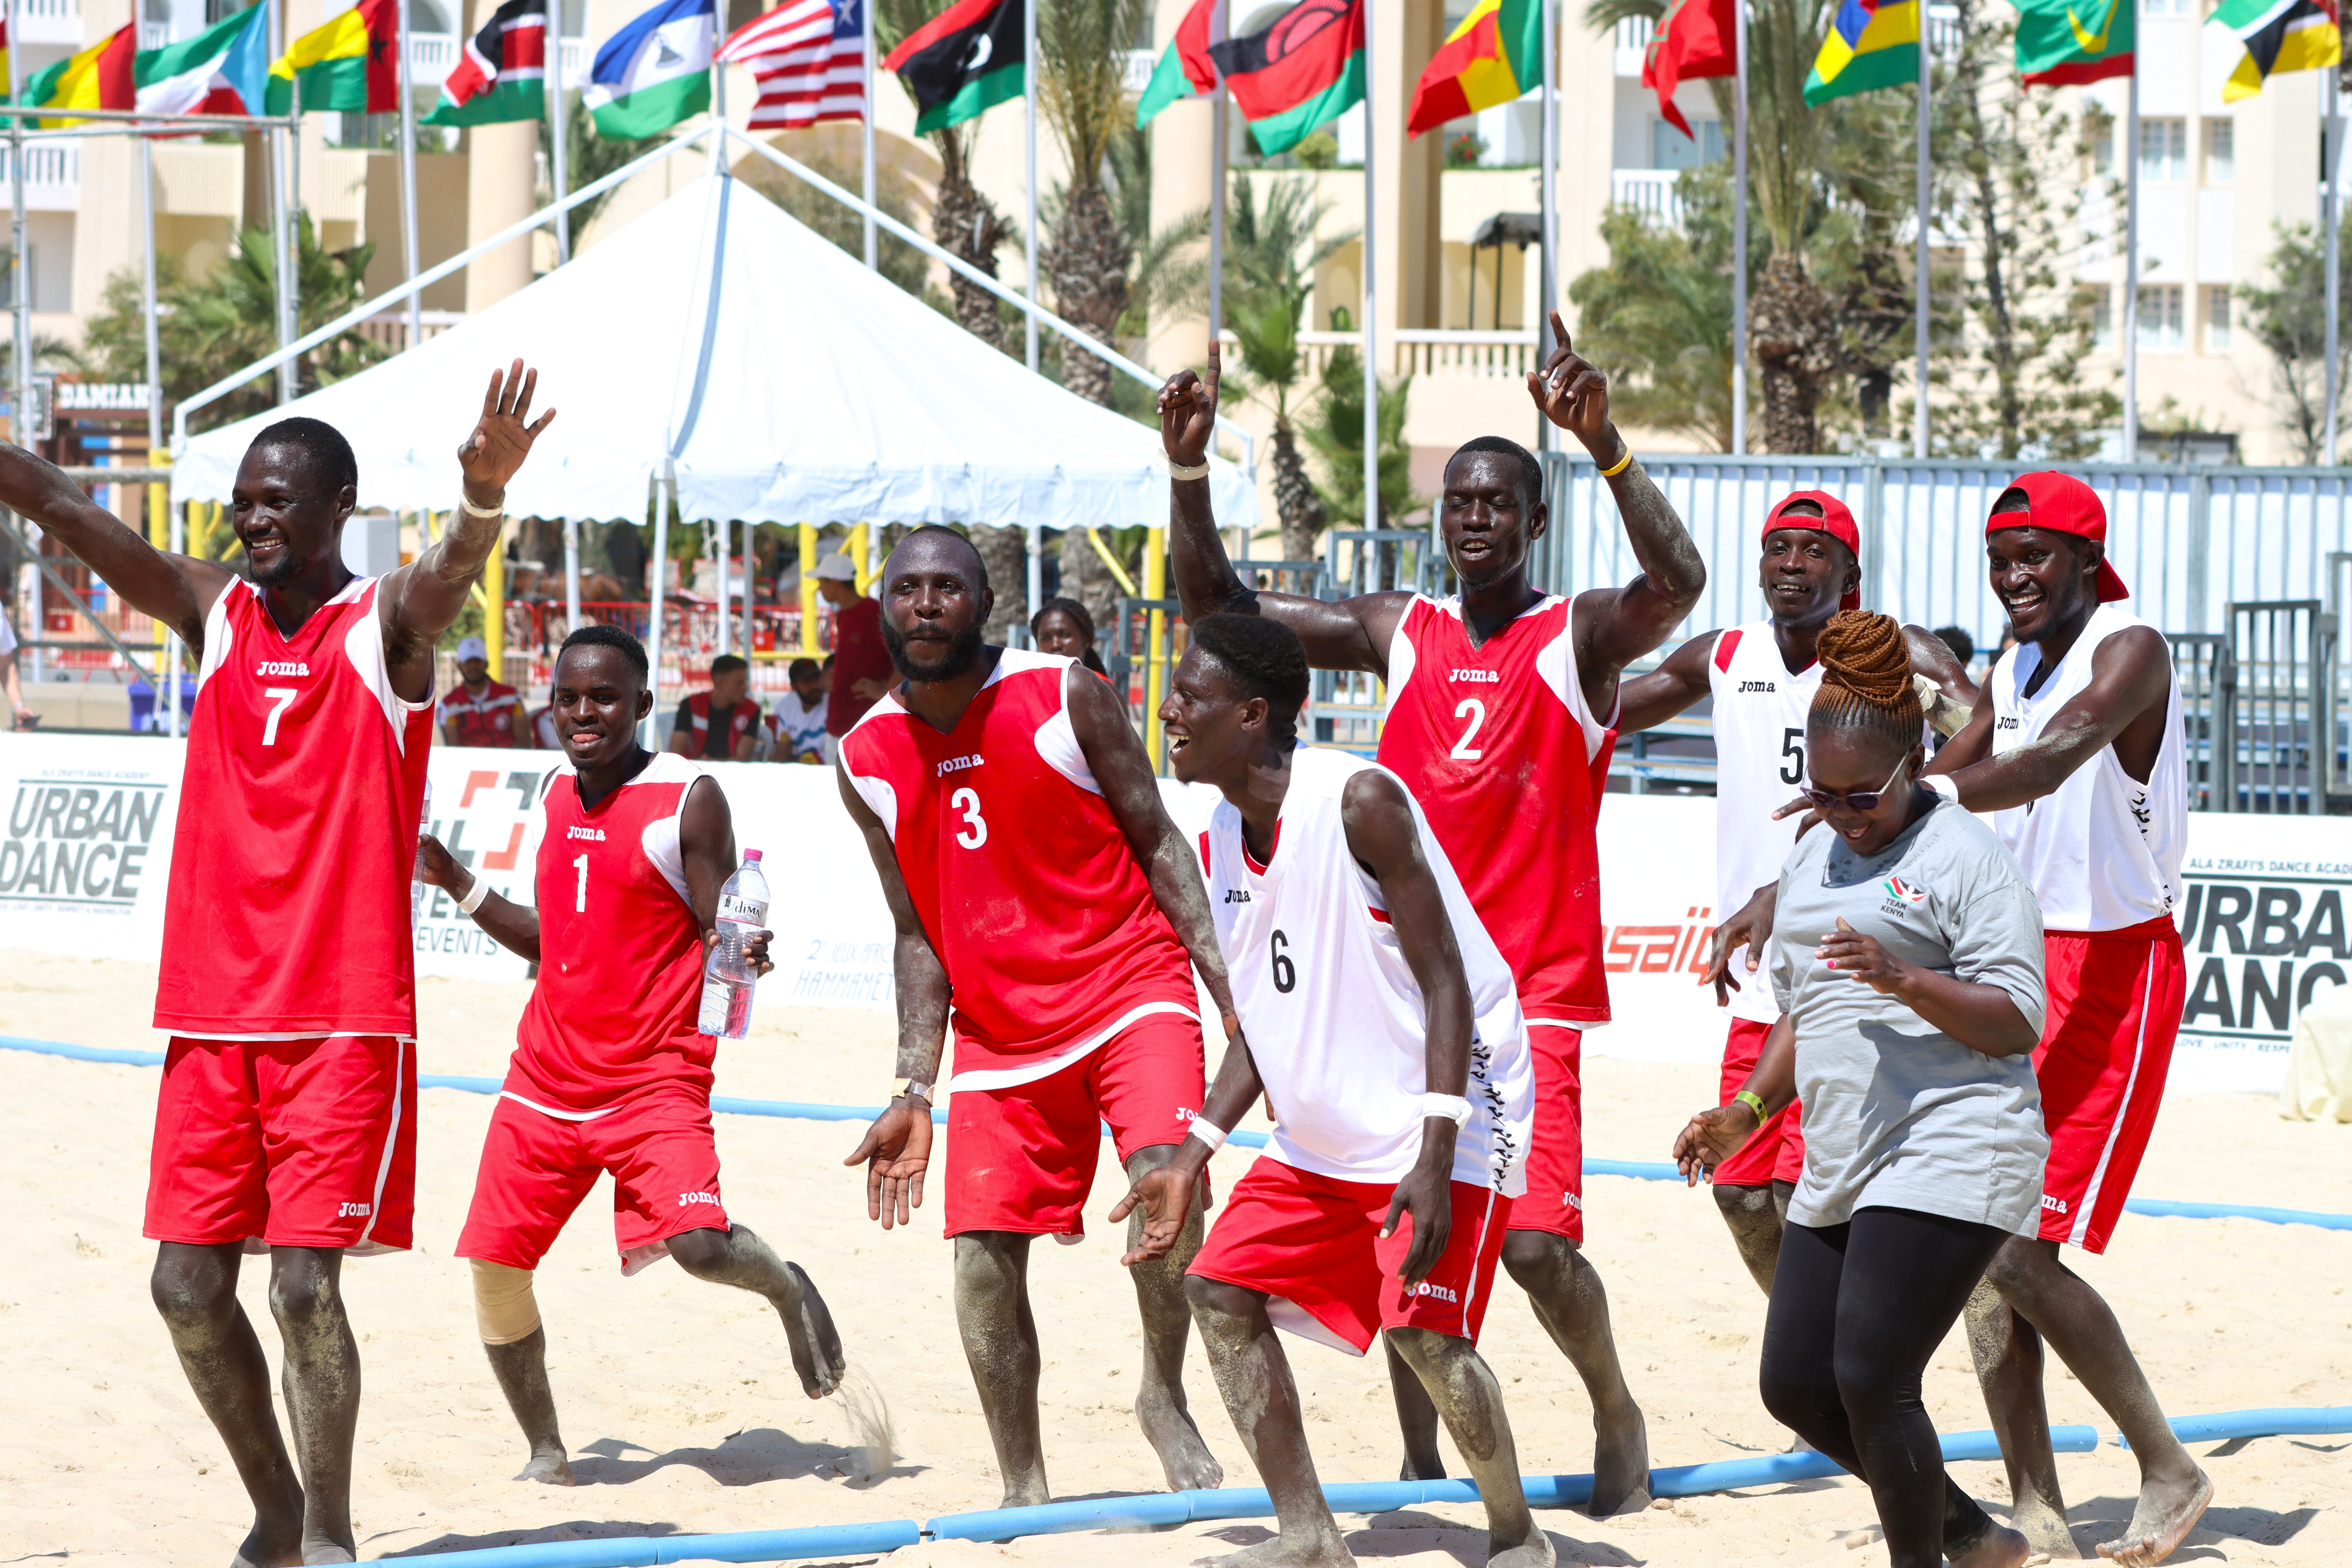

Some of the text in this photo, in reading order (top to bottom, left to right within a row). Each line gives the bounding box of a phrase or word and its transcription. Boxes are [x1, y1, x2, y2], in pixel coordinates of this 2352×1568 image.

[256, 661, 309, 676] Joma
[1449, 669, 1499, 682] Joma
[1738, 681, 1776, 693] Joma
[262, 688, 298, 745] 7
[1450, 699, 1485, 759] 2
[937, 754, 984, 777] Joma
[1780, 728, 1804, 785] 5
[9, 787, 165, 843] URBAN
[951, 787, 987, 849] 3
[567, 826, 606, 841] Joma
[0, 840, 149, 898] DANCE
[2189, 858, 2213, 869] ALA
[2270, 861, 2311, 873] DANCE
[573, 854, 588, 912] 1
[1225, 889, 1251, 904] Joma
[1886, 898, 1907, 910] TEAM
[1880, 905, 1904, 919] KENYA
[416, 926, 498, 955] EVENTS
[1271, 929, 1296, 993] 6
[793, 970, 894, 1002] HAMMAMET
[2176, 1038, 2203, 1048] LOVE
[2213, 1041, 2247, 1050] UNITY
[1176, 1107, 1199, 1121] Jo
[338, 1202, 371, 1217] Joma
[1562, 1192, 1582, 1211] Jom
